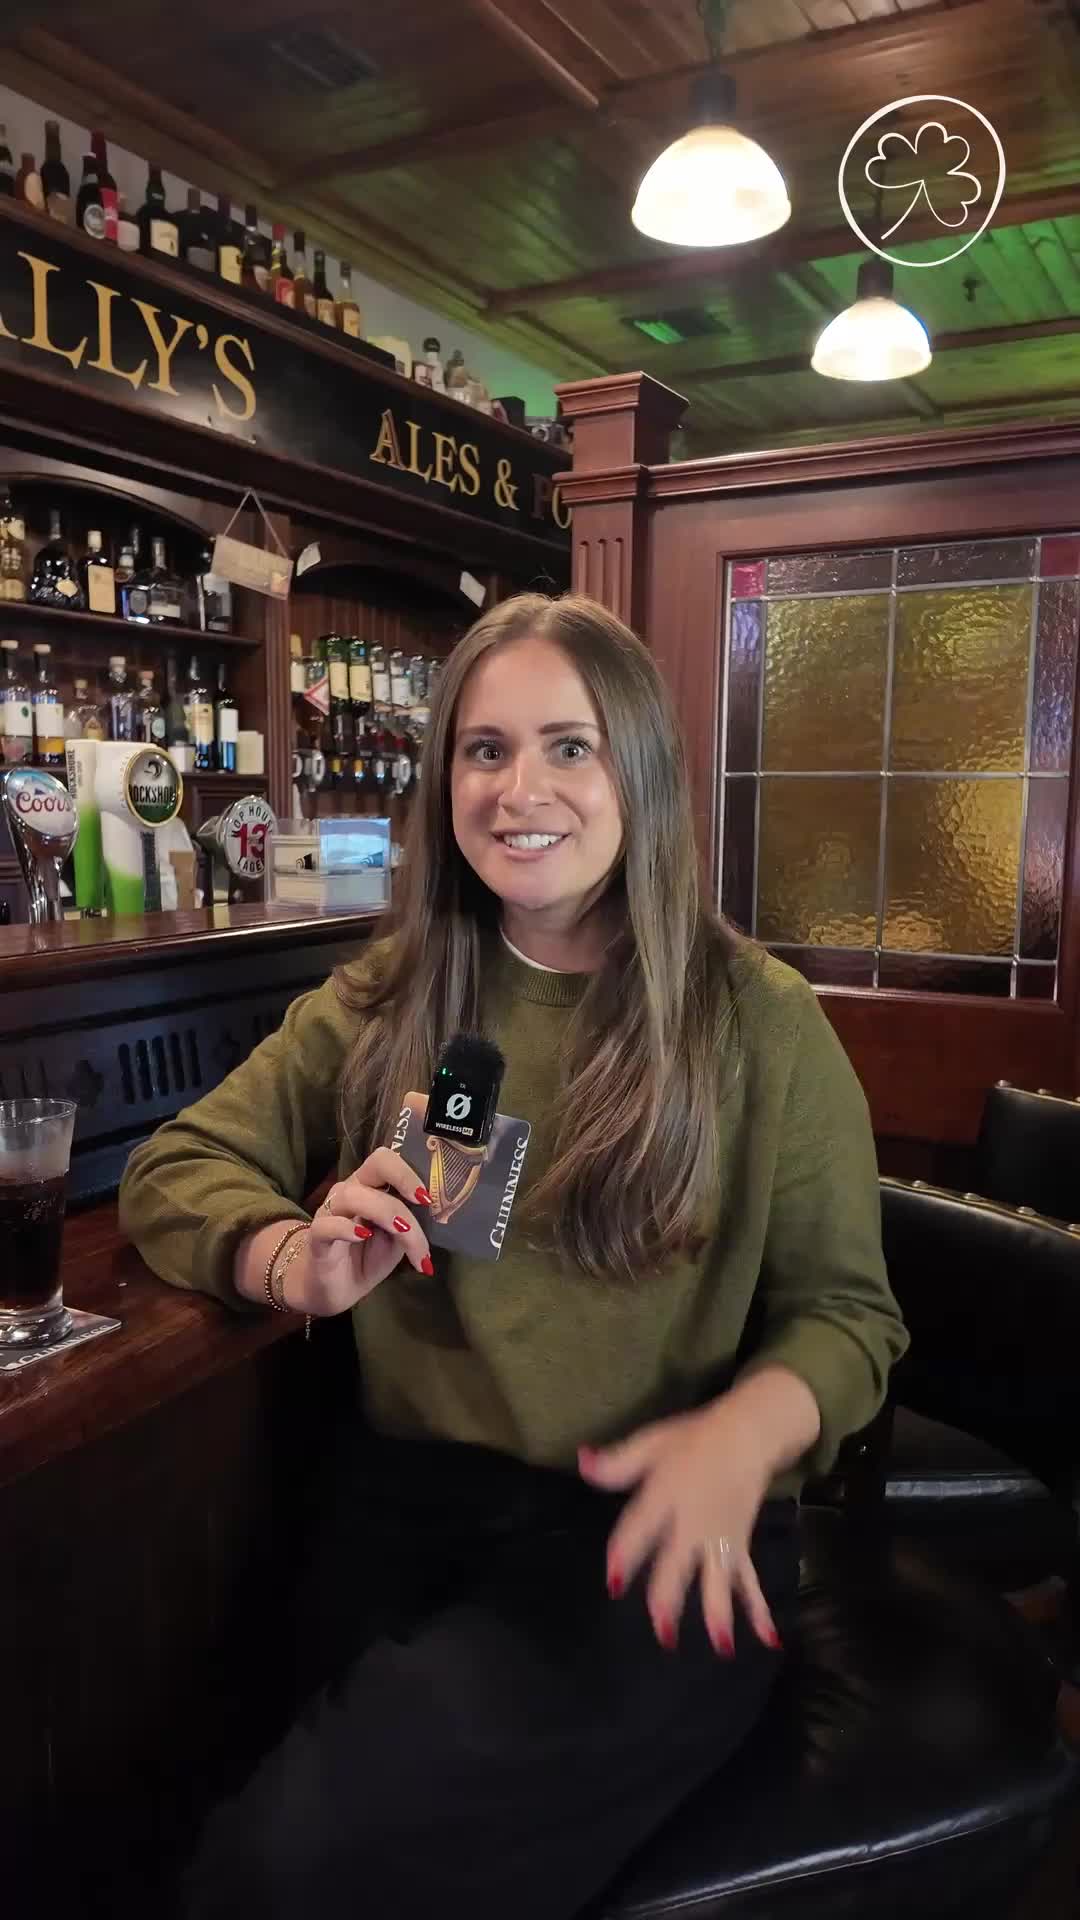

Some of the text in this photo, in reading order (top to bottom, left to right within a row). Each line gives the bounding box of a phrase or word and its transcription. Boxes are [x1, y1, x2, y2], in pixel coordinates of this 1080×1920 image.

[0, 251, 256, 421] LLY'S
[369, 408, 480, 495] ALES
[494, 459, 520, 511] &
[231, 810, 245, 838] HOP
[240, 823, 268, 859] 13
[435, 1122, 462, 1133] WIRELESS
[489, 1137, 528, 1249] GUINNESS
